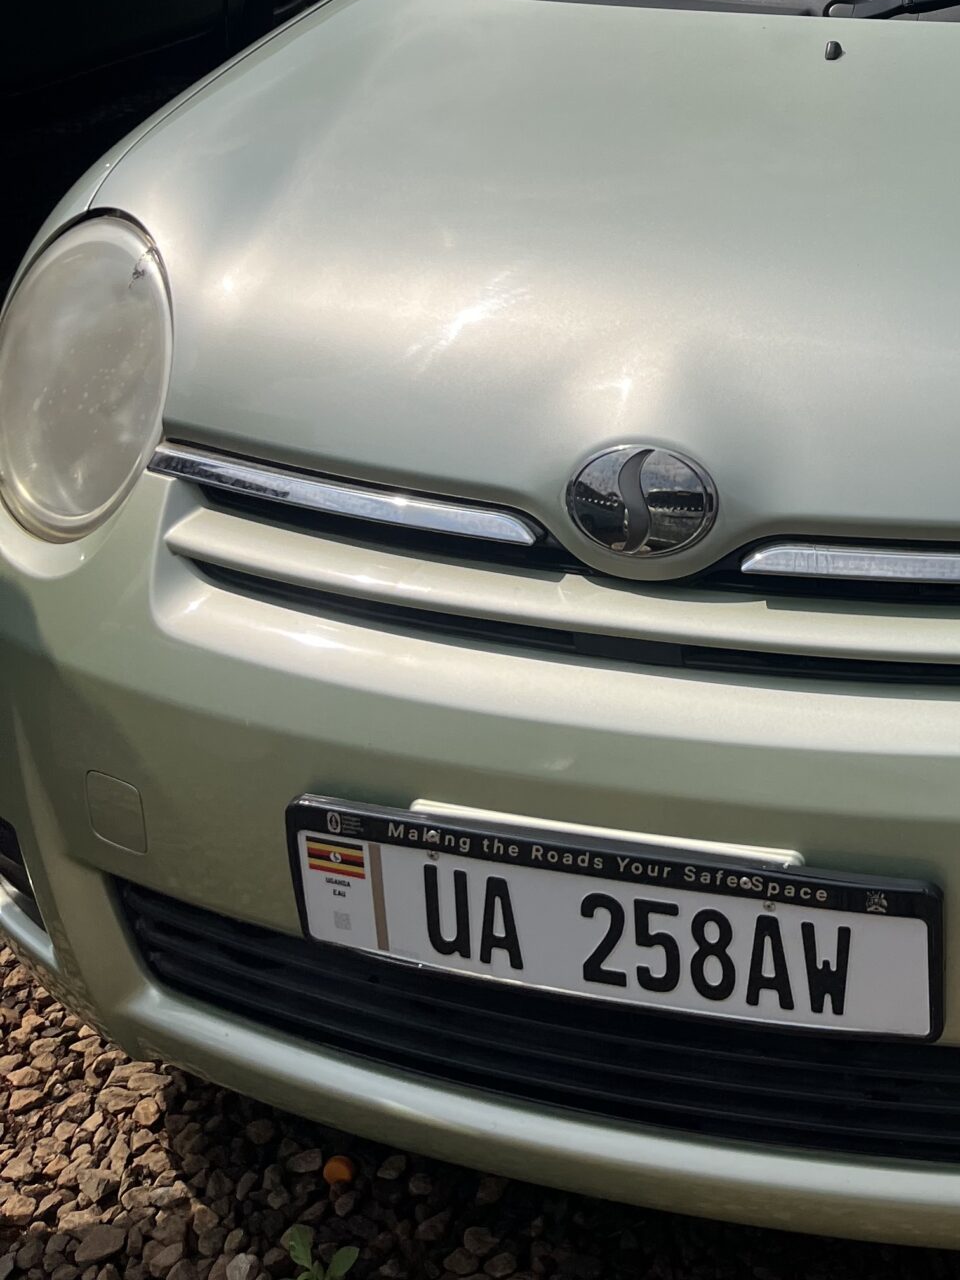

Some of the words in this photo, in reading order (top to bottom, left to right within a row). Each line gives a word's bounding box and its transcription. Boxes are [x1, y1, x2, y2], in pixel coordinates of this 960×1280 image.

[388, 821, 471, 852] Making
[482, 838, 520, 857] the
[531, 843, 604, 869] Roads
[616, 856, 672, 879] Your
[683, 864, 738, 889] Safe
[750, 876, 829, 902] Space
[423, 863, 524, 970] UA
[579, 891, 852, 1016] 258AW
